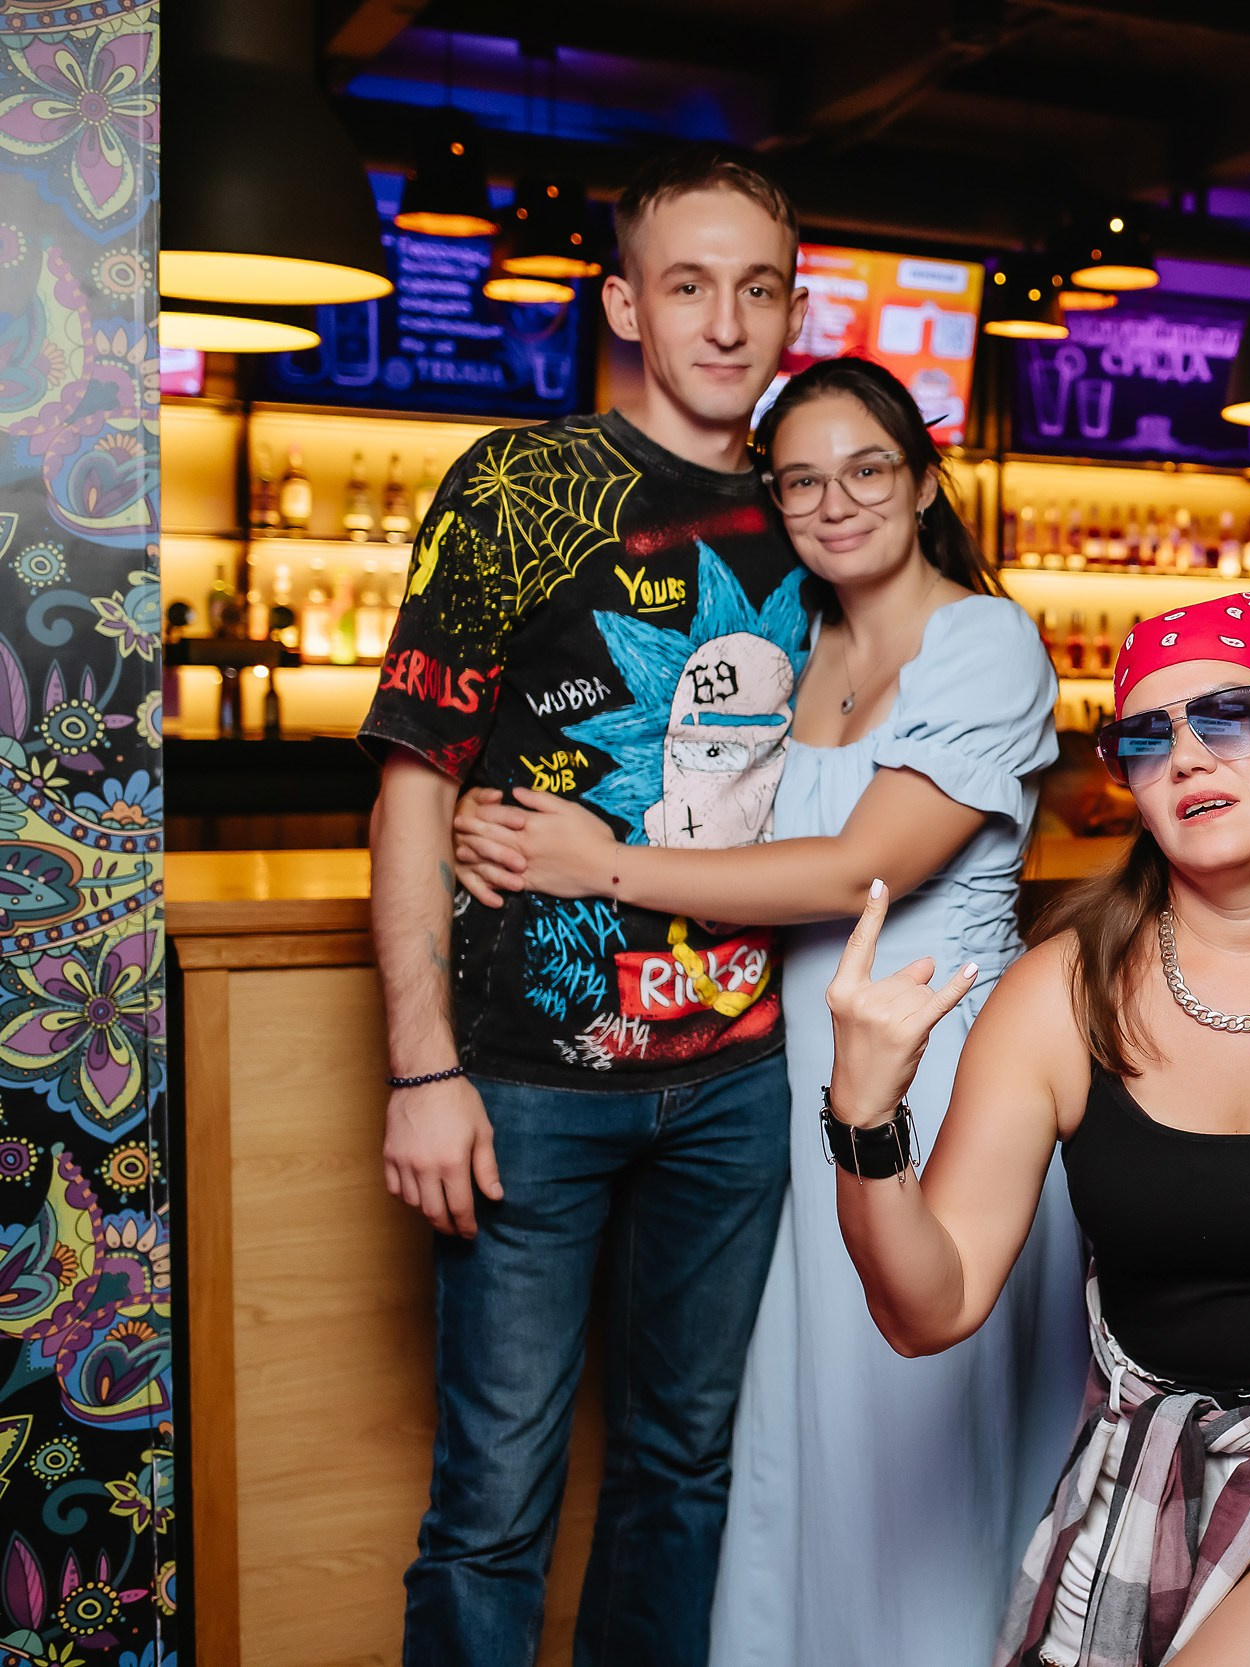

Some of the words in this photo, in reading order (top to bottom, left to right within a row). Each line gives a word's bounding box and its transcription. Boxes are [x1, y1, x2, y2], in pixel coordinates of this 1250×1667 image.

[614, 564, 687, 606] YOURS
[526, 676, 612, 717] WUBBA
[531, 771, 577, 793] DUB
